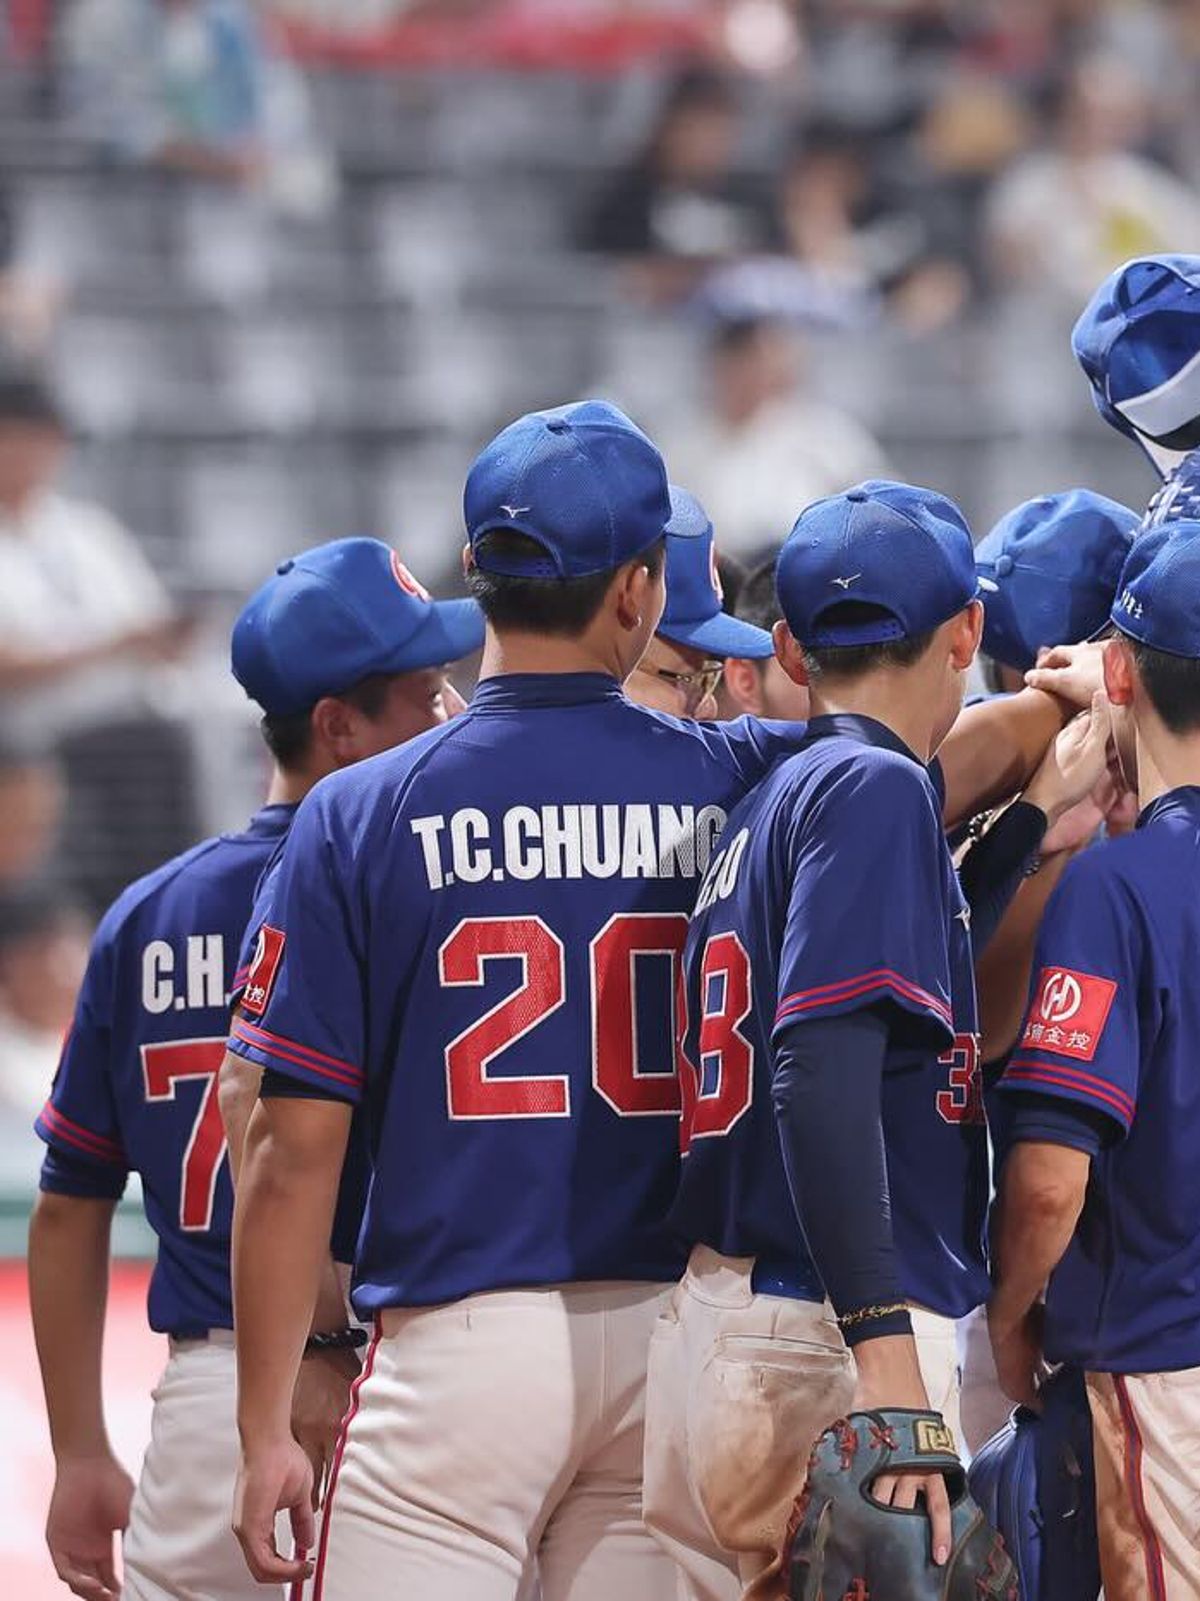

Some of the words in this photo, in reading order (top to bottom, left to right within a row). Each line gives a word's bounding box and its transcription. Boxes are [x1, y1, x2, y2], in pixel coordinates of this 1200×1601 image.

[410, 803, 729, 890] T.C.CHUANG
[438, 912, 689, 1121] 20
[680, 930, 755, 1158] 8
[139, 1036, 229, 1232] 7
